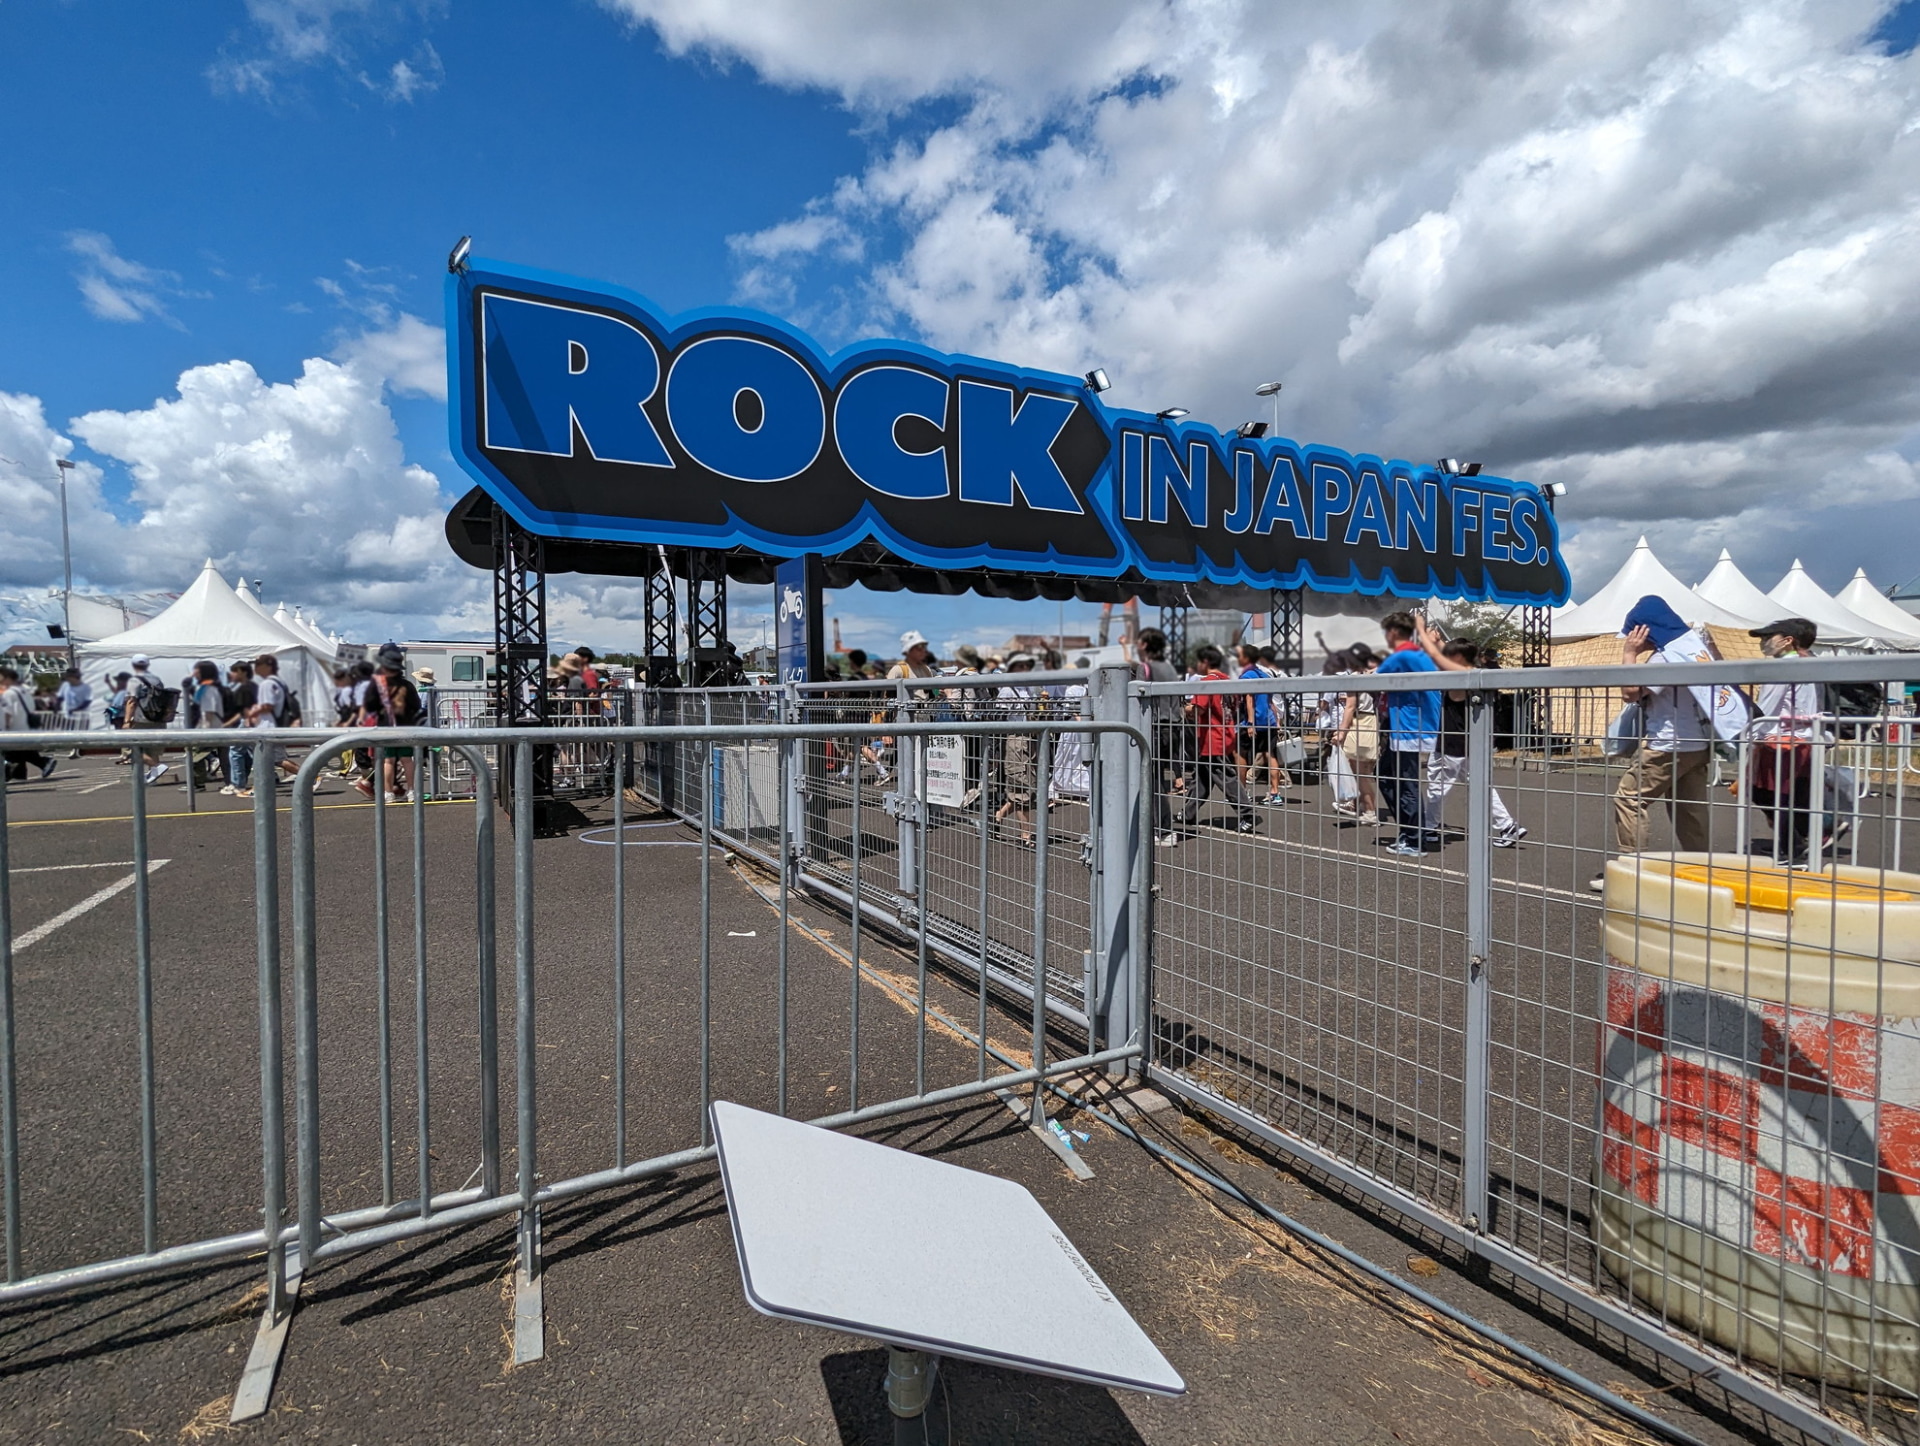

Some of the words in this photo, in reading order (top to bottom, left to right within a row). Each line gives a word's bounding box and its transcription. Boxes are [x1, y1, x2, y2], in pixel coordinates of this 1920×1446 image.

[480, 291, 1085, 515] ROCK
[1122, 430, 1209, 528] IN
[1223, 449, 1438, 553] JAPAN
[1451, 487, 1550, 567] FES.
